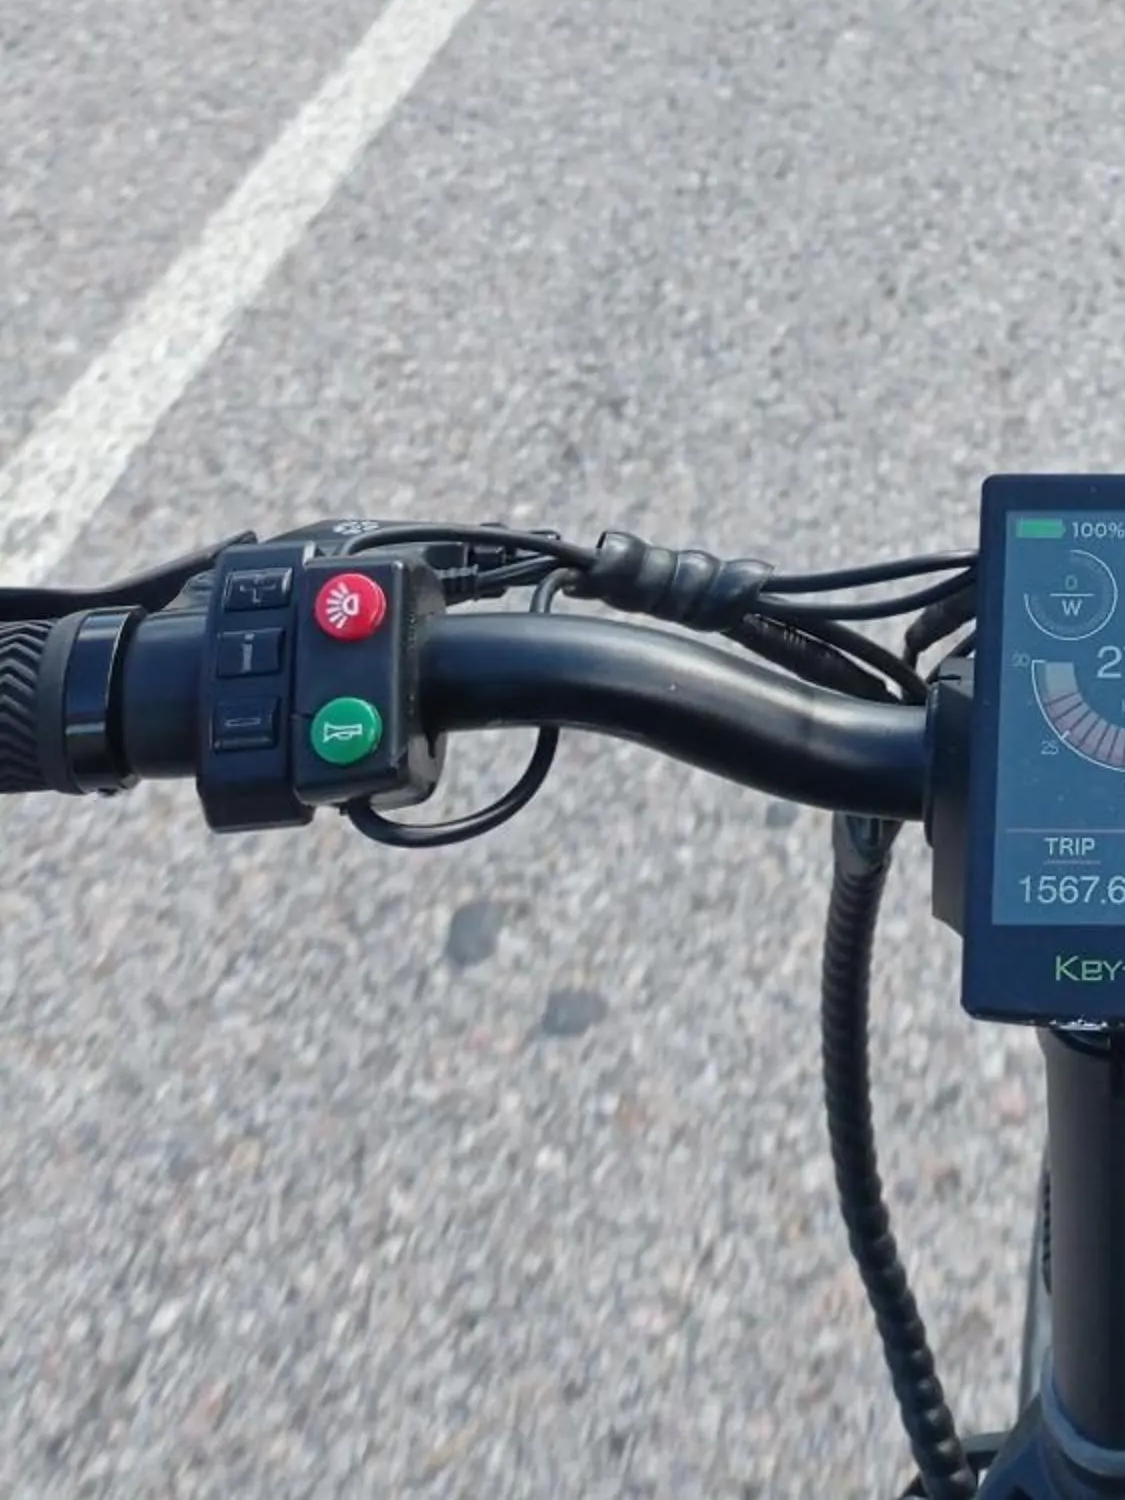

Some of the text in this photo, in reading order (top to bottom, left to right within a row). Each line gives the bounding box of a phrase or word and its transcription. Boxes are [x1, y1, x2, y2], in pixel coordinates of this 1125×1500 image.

[1071, 521, 1125, 538] 100%
[1060, 600, 1082, 616] W
[1044, 837, 1096, 857] TRIP
